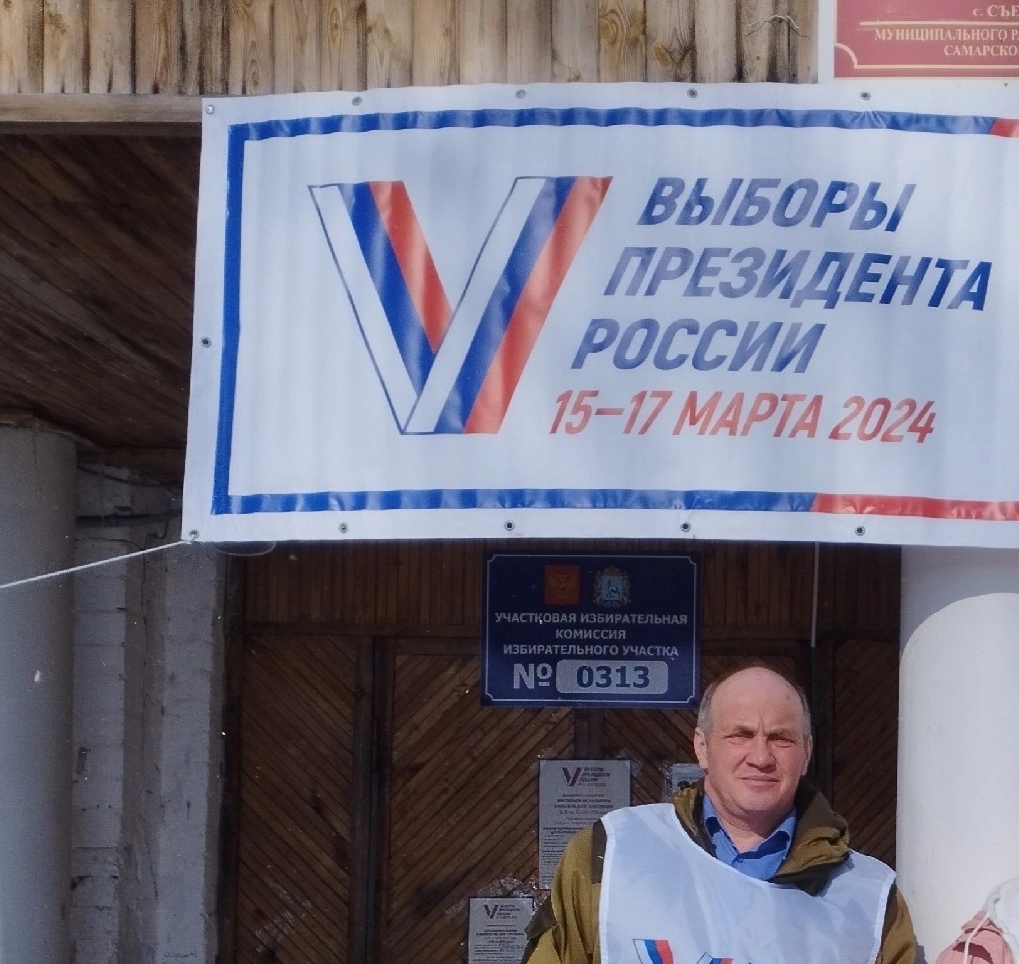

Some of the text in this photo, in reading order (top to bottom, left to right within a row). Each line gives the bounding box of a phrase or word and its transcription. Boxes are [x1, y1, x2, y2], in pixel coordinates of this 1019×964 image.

[874, 28, 1007, 42] МУНИЦИПАЛЬНОГО
[637, 177, 915, 233] ВЫБОРЫ
[603, 246, 993, 311] ПРЕЗИДЕНТА
[571, 318, 826, 374] РОССИИ
[673, 392, 823, 441] МАРТА
[828, 395, 936, 444] 2024
[495, 612, 688, 625] УЧАСТКОВАЯ ИЗБИРАТЕЛЬНАЯ
[555, 629, 627, 640] КОМИССИЯ
[503, 644, 679, 657] ИЗБИРАТЕЛЬНОГО УЧАСТКА
[513, 663, 650, 689] № 0313
